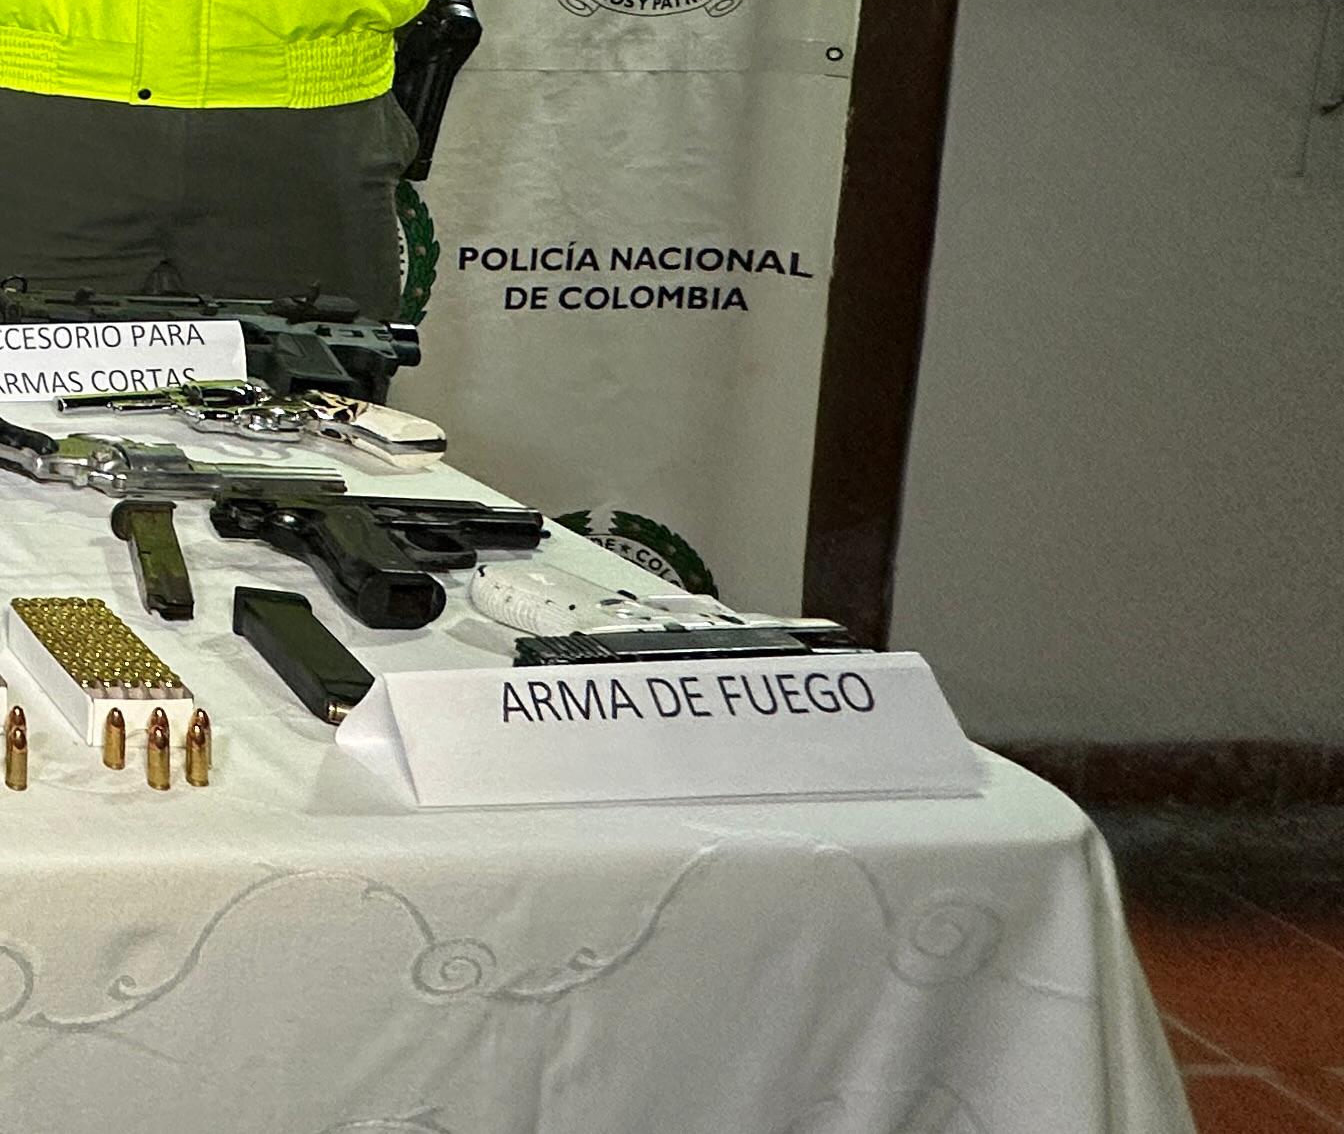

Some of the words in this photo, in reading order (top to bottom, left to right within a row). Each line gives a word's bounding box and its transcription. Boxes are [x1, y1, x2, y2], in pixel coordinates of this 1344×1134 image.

[459, 242, 599, 271] POLICÍA
[611, 247, 813, 278] NACIONAL
[505, 287, 548, 309] DE
[559, 286, 748, 311] COLOMBIA
[131, 324, 205, 346] PARA
[91, 367, 196, 392] CORTAS
[503, 679, 644, 722] ARMA
[651, 677, 712, 717] DE
[717, 672, 874, 715] FUEGO
